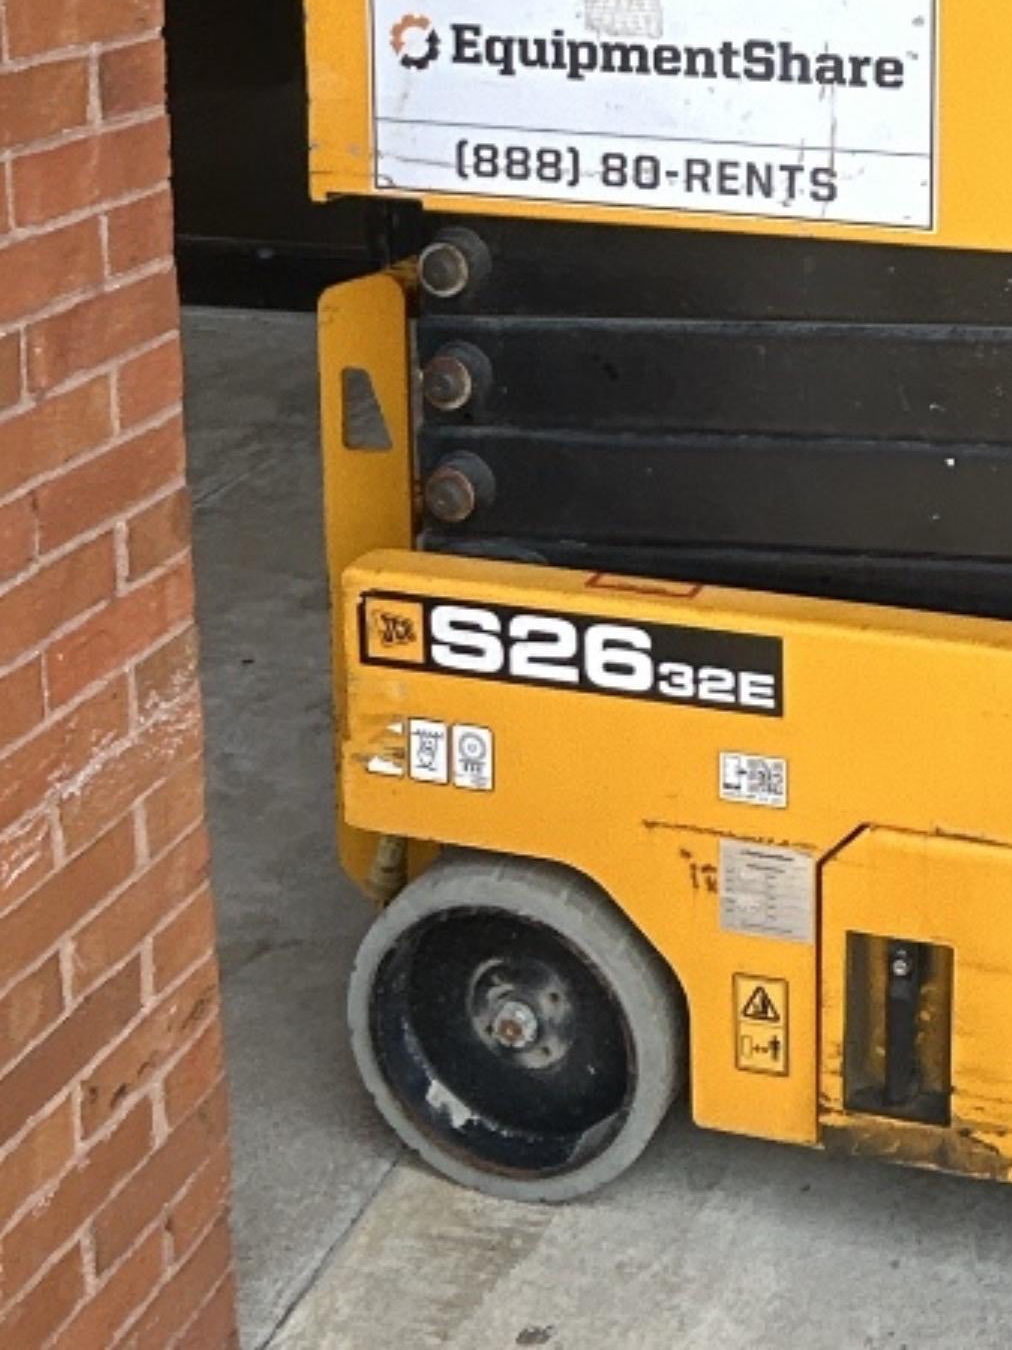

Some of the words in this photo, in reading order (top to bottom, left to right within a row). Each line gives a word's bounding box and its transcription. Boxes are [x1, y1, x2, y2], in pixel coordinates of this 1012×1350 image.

[451, 22, 904, 89] EquipmentShare
[456, 139, 581, 187] (888)
[601, 150, 838, 202] 80-RENTS
